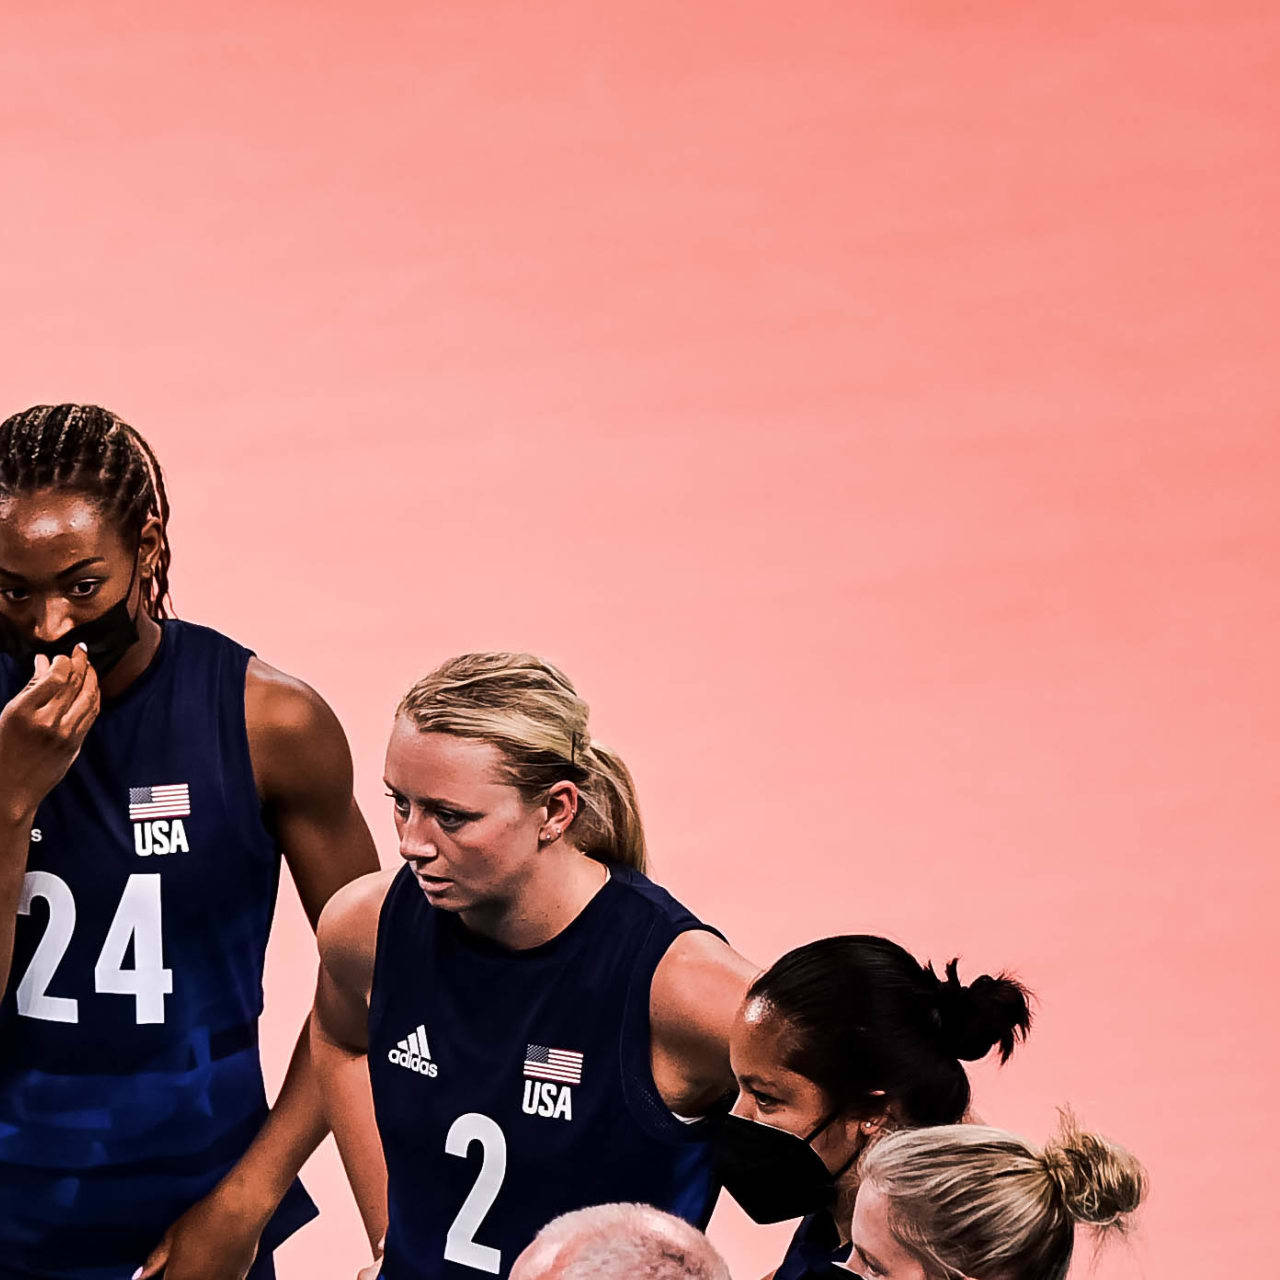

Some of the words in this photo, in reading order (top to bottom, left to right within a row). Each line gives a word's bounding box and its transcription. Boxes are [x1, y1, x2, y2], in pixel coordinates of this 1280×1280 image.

[134, 821, 189, 856] USA
[16, 871, 173, 1024] 24
[388, 1049, 438, 1078] adidas
[522, 1079, 572, 1120] USA
[444, 1113, 507, 1274] 2
